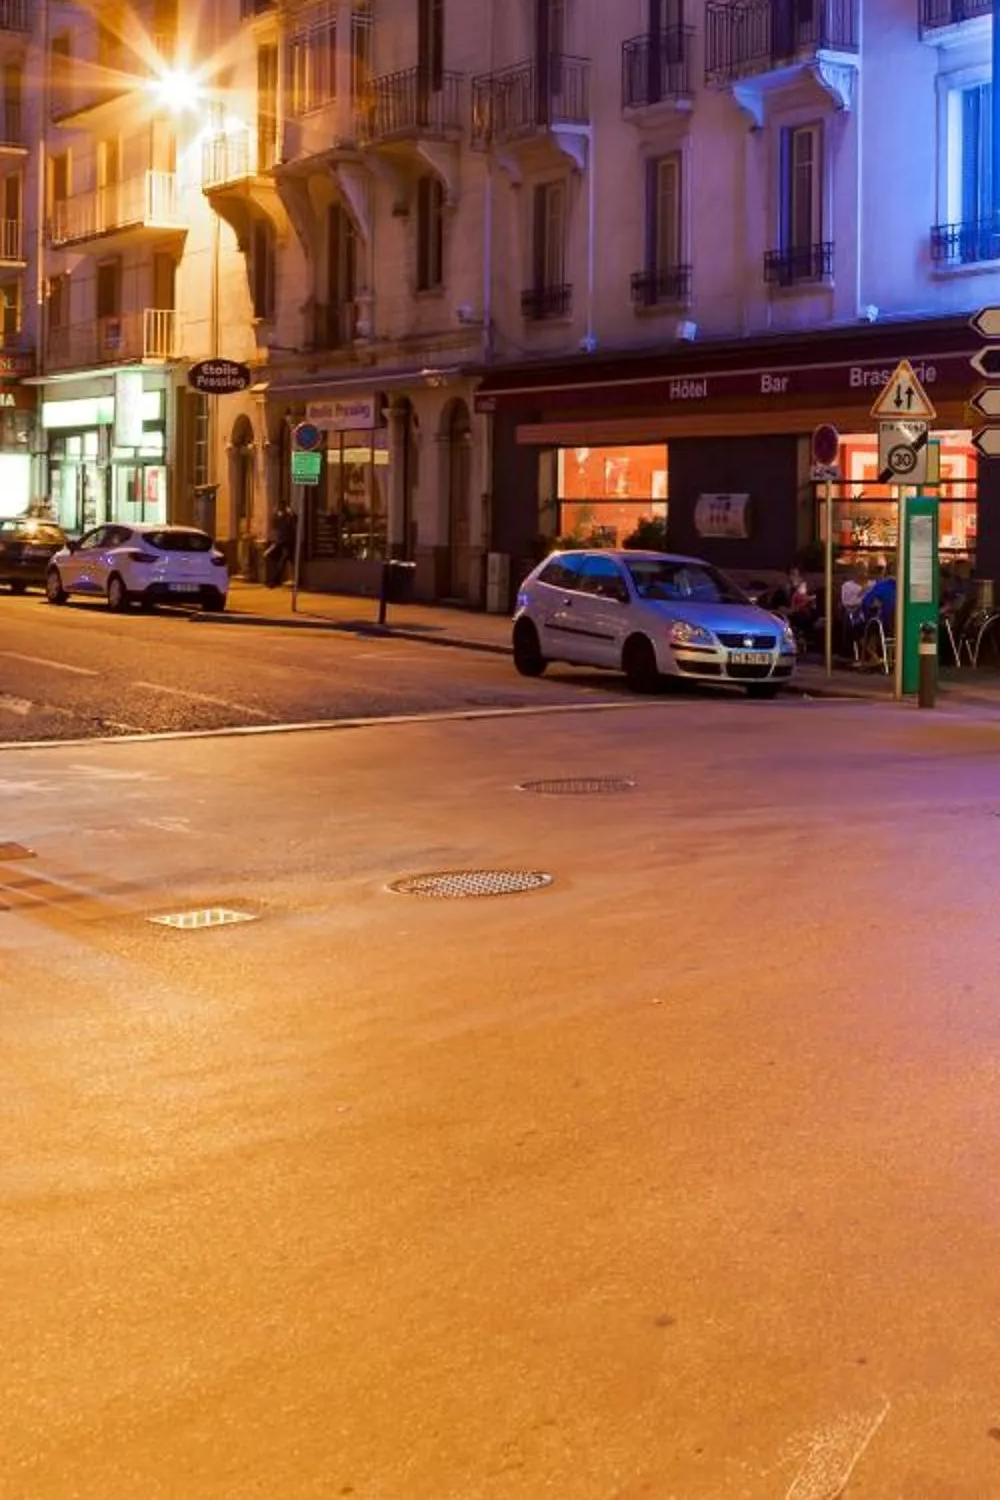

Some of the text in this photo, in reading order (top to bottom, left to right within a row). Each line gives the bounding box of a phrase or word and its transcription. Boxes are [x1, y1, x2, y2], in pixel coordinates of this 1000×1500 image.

[669, 377, 709, 400] Hôtel
[760, 373, 790, 395] Bar
[894, 452, 912, 467] 30
